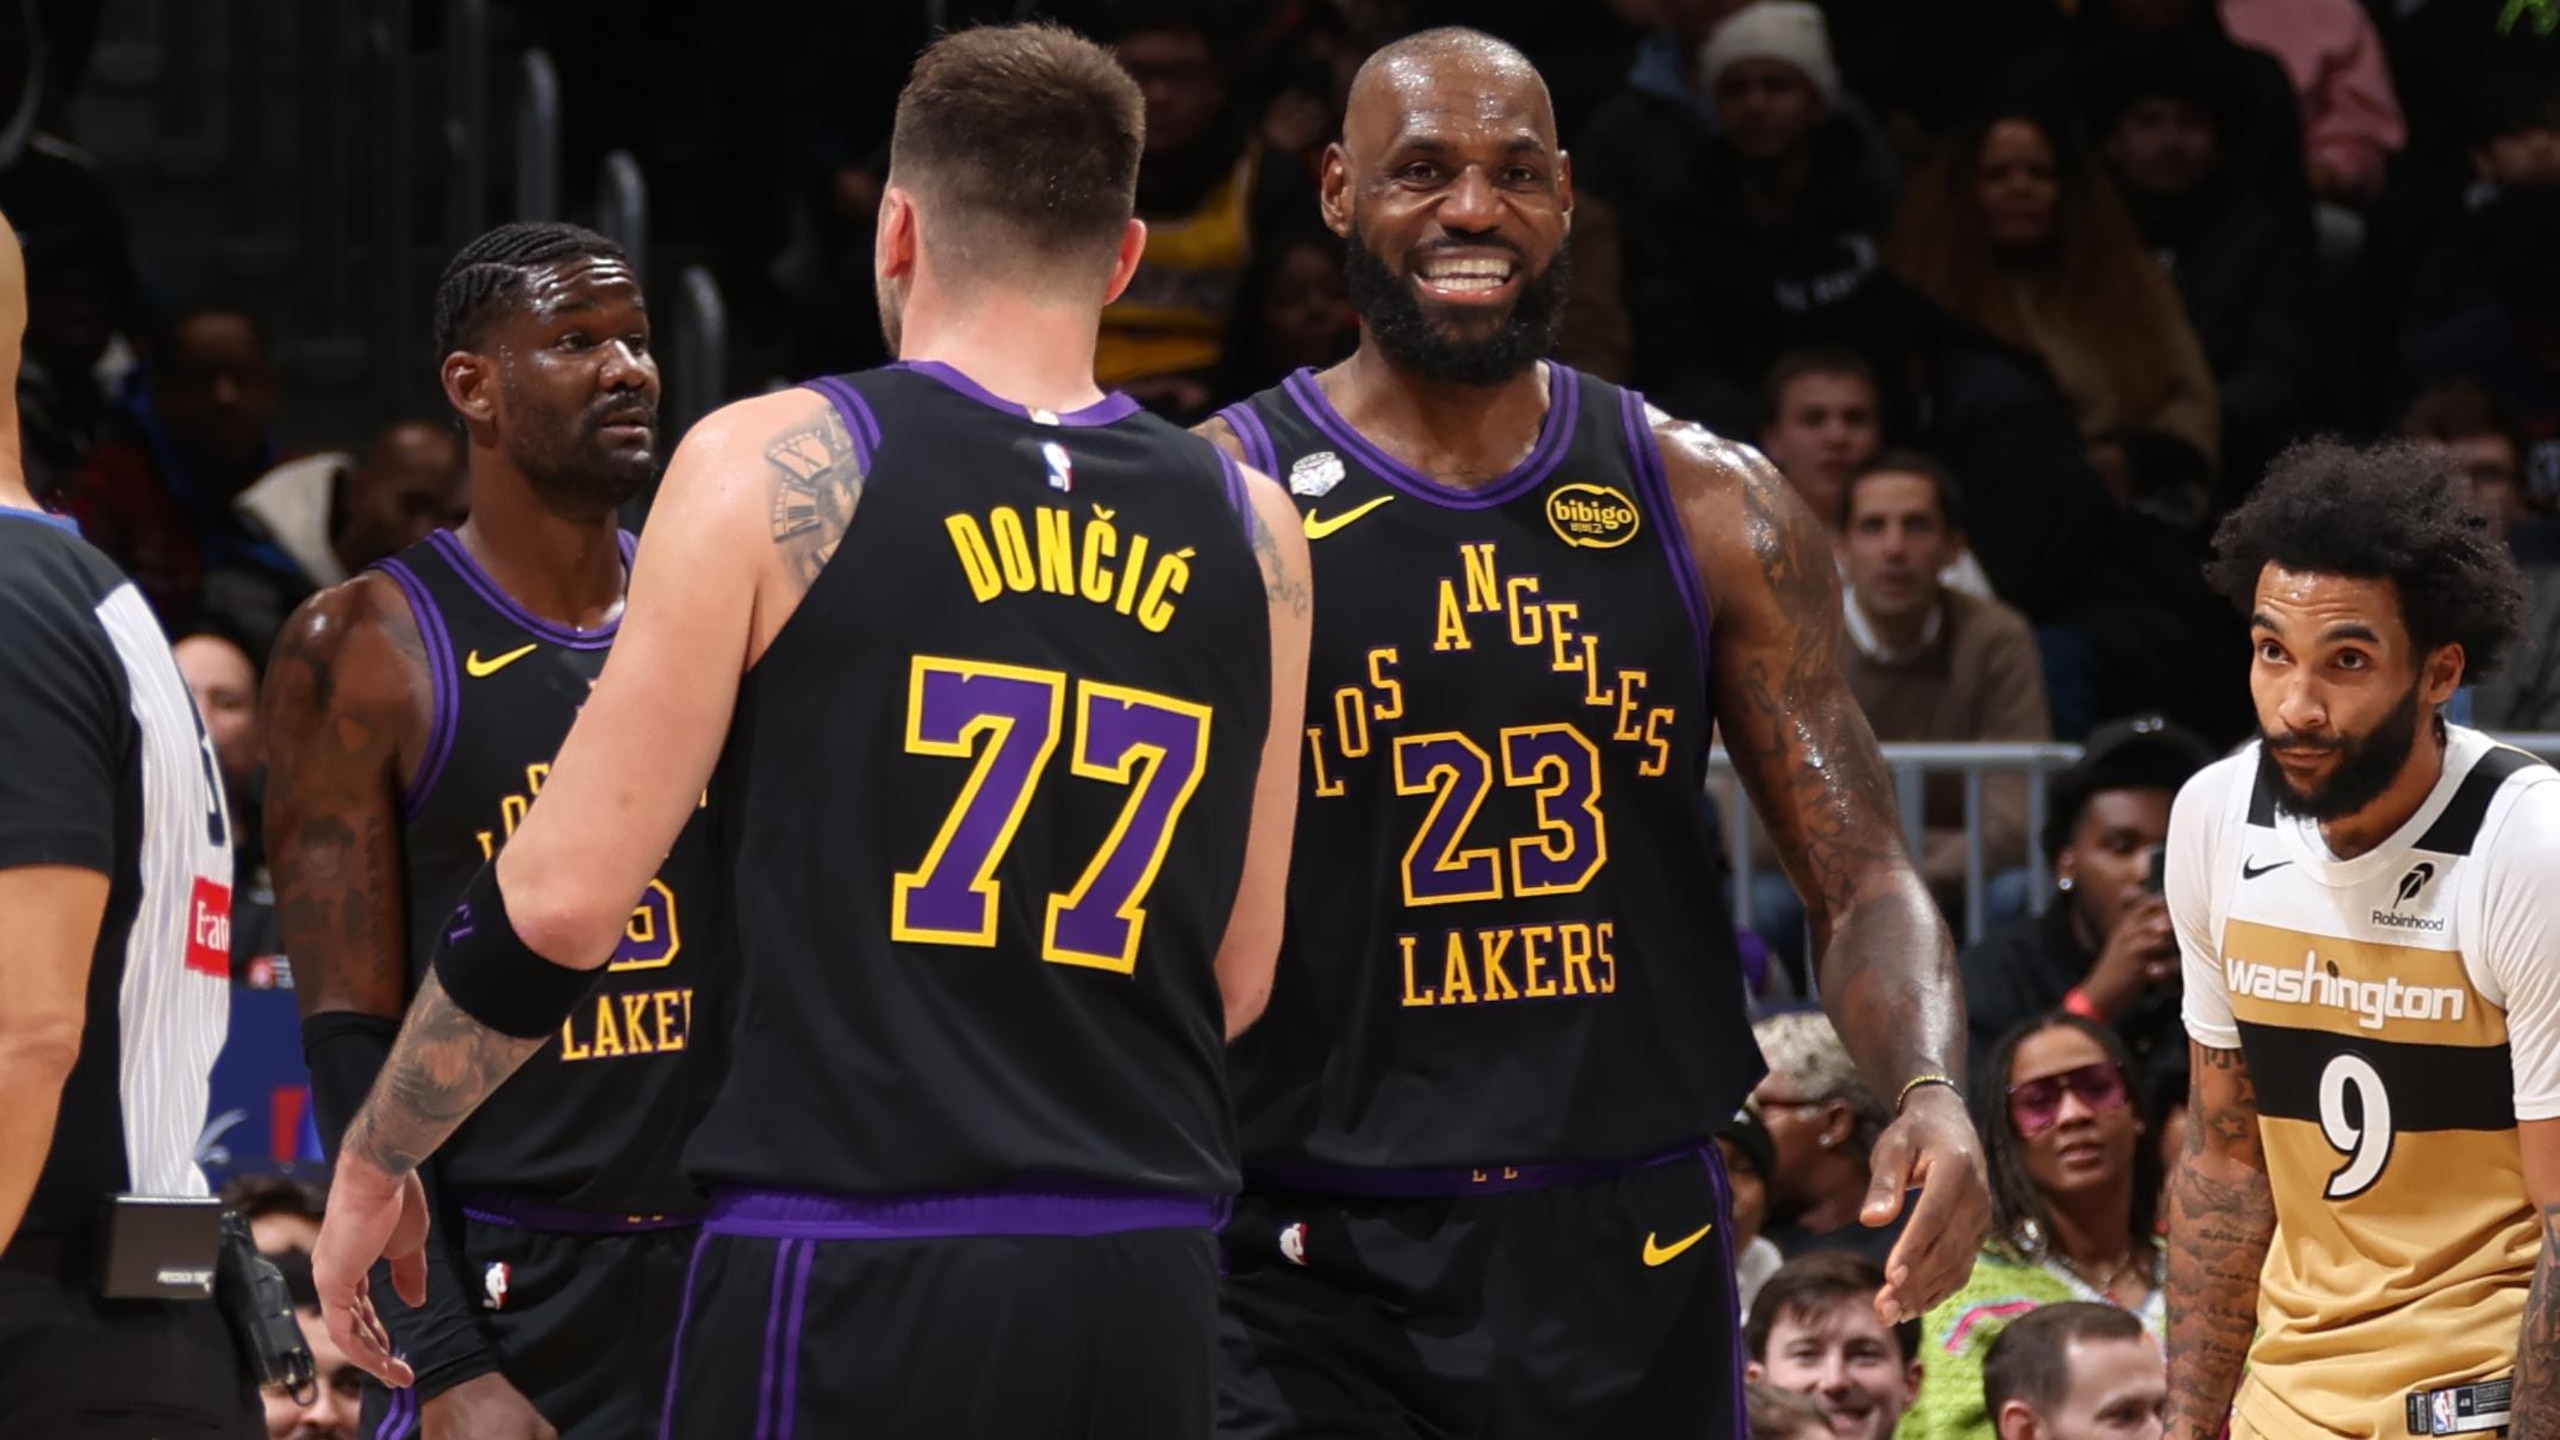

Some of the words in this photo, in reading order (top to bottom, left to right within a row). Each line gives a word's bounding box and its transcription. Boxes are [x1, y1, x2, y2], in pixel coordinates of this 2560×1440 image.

[945, 503, 1195, 632] DONČIĆ
[1554, 499, 1632, 530] bibigo
[1307, 648, 1403, 797] LOS
[1432, 543, 1674, 776] ANGELES
[891, 655, 1213, 974] 77
[1393, 723, 1607, 906] 23
[1399, 922, 1615, 1006] LAKERS
[2372, 910, 2445, 931] Robinhood
[561, 989, 693, 1061] LAKE
[2225, 950, 2465, 1030] washington
[2318, 1051, 2395, 1200] 9
